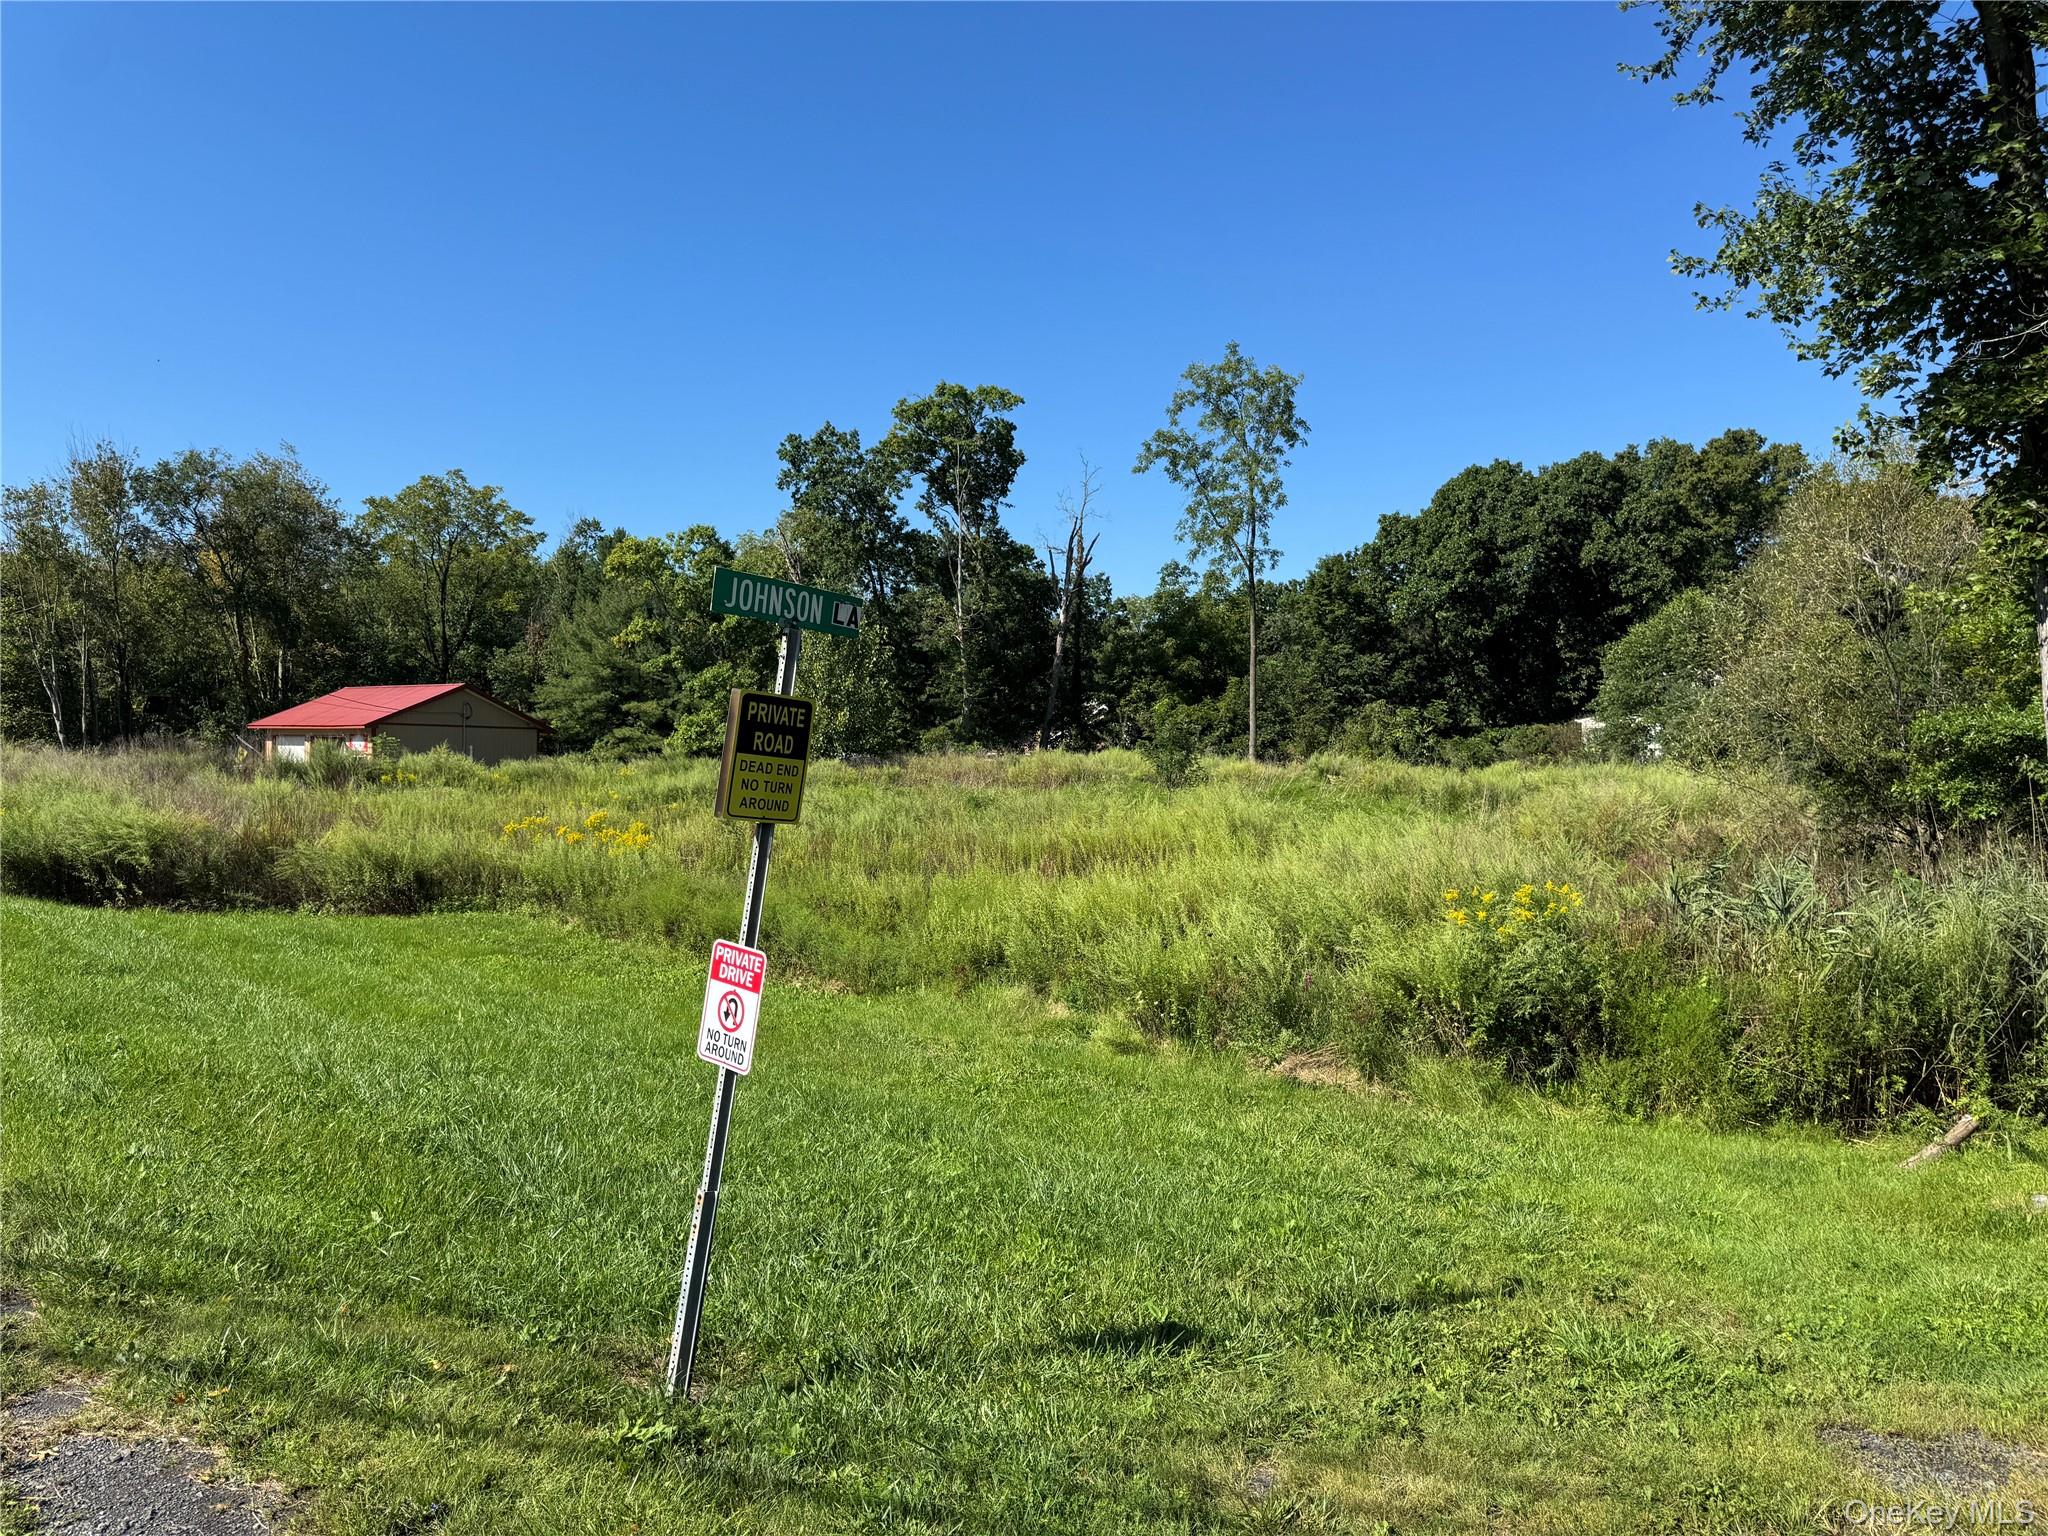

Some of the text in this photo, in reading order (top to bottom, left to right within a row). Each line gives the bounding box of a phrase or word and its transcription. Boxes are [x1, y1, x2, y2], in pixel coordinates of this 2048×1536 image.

[724, 577, 859, 629] JOHNSON LA
[748, 701, 806, 728] PRIVATE
[753, 732, 794, 755] ROAD
[740, 760, 799, 777] DEAD END
[741, 778, 793, 794] NO TURN
[739, 797, 789, 812] AROUND
[715, 945, 763, 973] PRIVATE
[719, 964, 754, 988] DRIVE
[706, 1028, 747, 1053] NO TURN
[704, 1042, 744, 1066] AROUND
